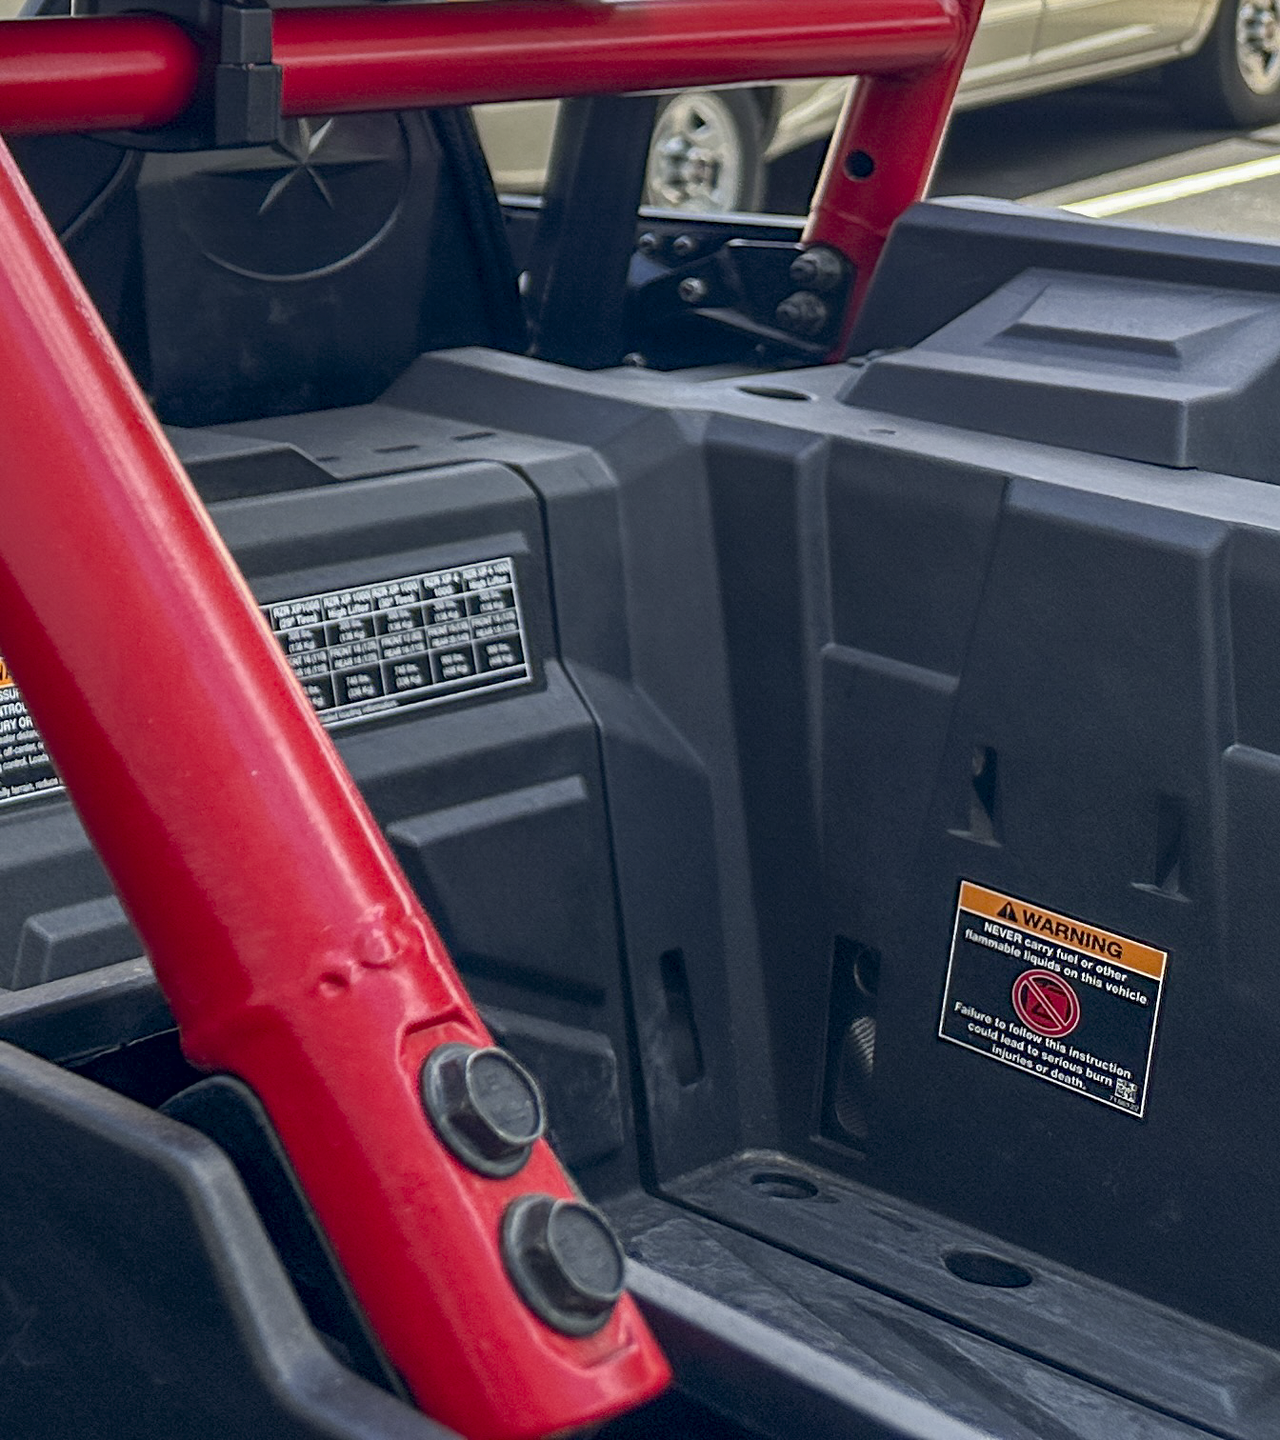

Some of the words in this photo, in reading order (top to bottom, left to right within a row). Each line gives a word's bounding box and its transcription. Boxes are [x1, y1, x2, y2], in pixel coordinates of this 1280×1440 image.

[983, 922, 1022, 943] NEVER
[1023, 939, 1053, 956] carry
[1056, 949, 1078, 964] fuel
[1080, 958, 1093, 970] or
[1095, 963, 1127, 982] other
[1021, 911, 1123, 958] WARNING
[964, 929, 1021, 957] flammable
[1022, 950, 1061, 973] liquids
[1062, 967, 1077, 978] on
[1080, 972, 1103, 988] this
[1104, 980, 1147, 1004] vehicle
[954, 1001, 992, 1024] Failure
[994, 1018, 1006, 1029] to
[1008, 1023, 1042, 1044] follow
[1044, 1037, 1066, 1053] this
[1068, 1047, 1131, 1078] instruction
[967, 1021, 998, 1040] could
[1000, 1034, 1024, 1050] lead
[1026, 1045, 1039, 1056] to
[1040, 1051, 1083, 1074] serious
[1085, 1068, 1112, 1086] burn
[991, 1045, 1032, 1069] injuries
[1035, 1063, 1048, 1074] or
[1050, 1069, 1087, 1089] death.
